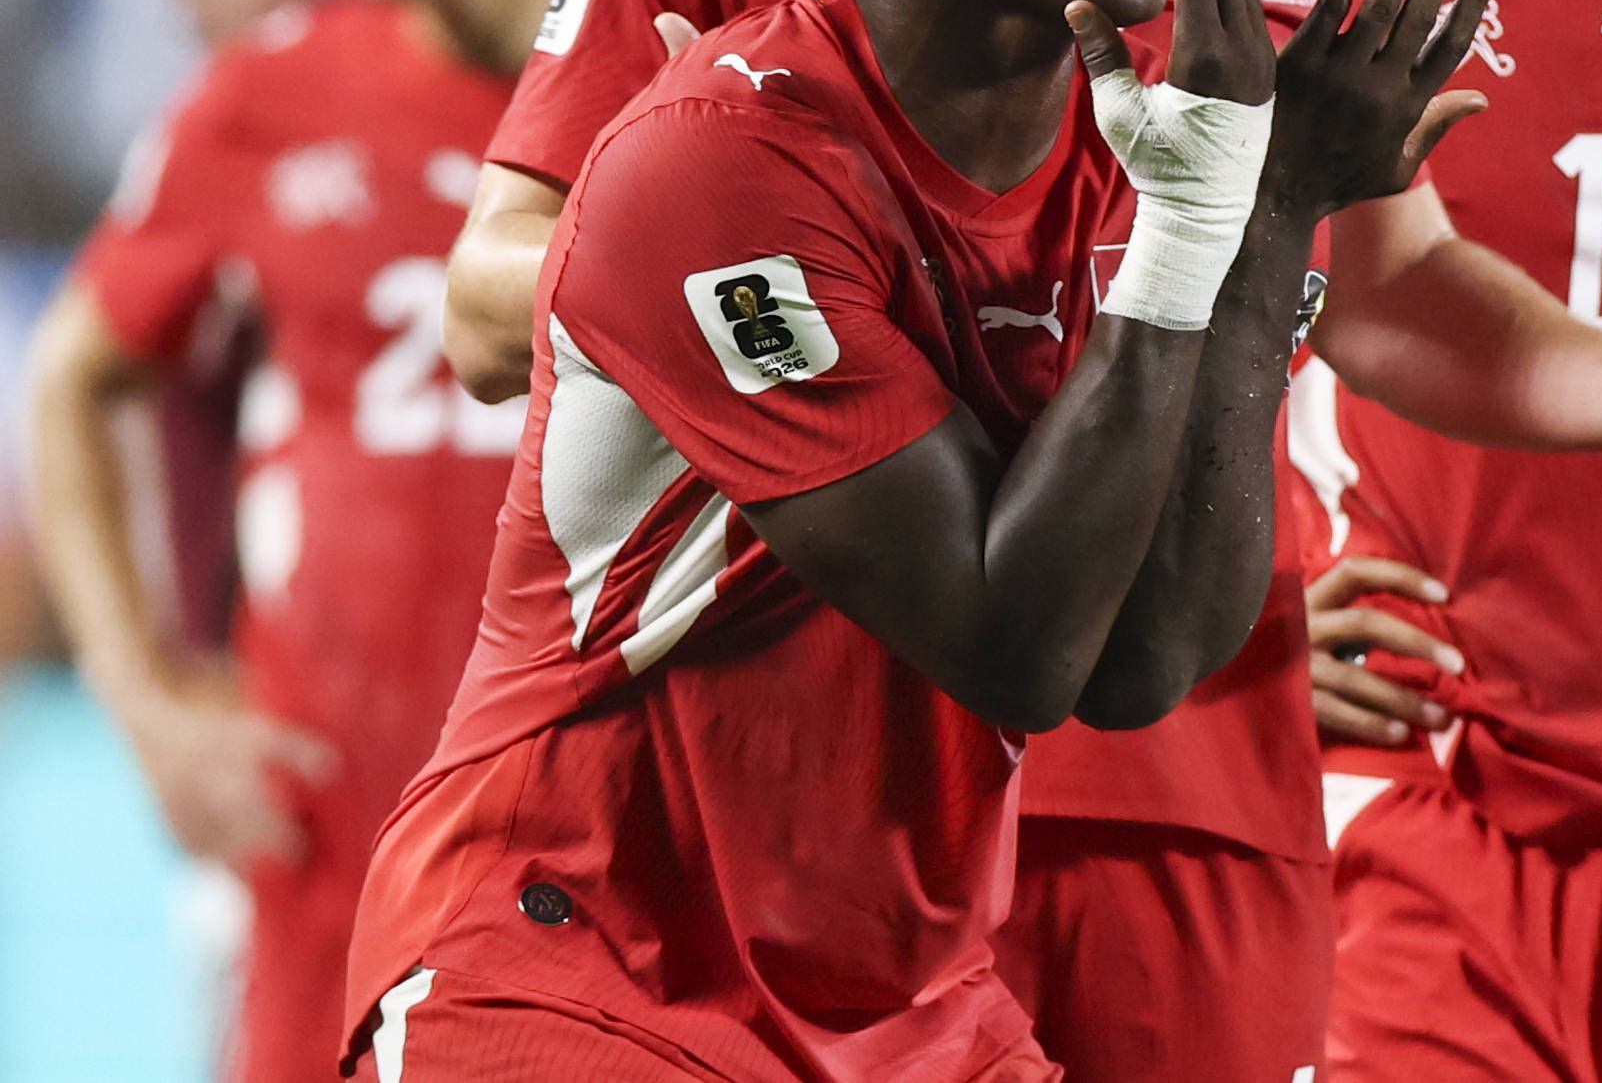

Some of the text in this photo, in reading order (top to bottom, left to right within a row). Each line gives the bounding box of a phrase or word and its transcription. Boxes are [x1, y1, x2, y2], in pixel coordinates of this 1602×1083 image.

[754, 337, 781, 351] FIFA
[755, 349, 803, 371] ORLD CUP
